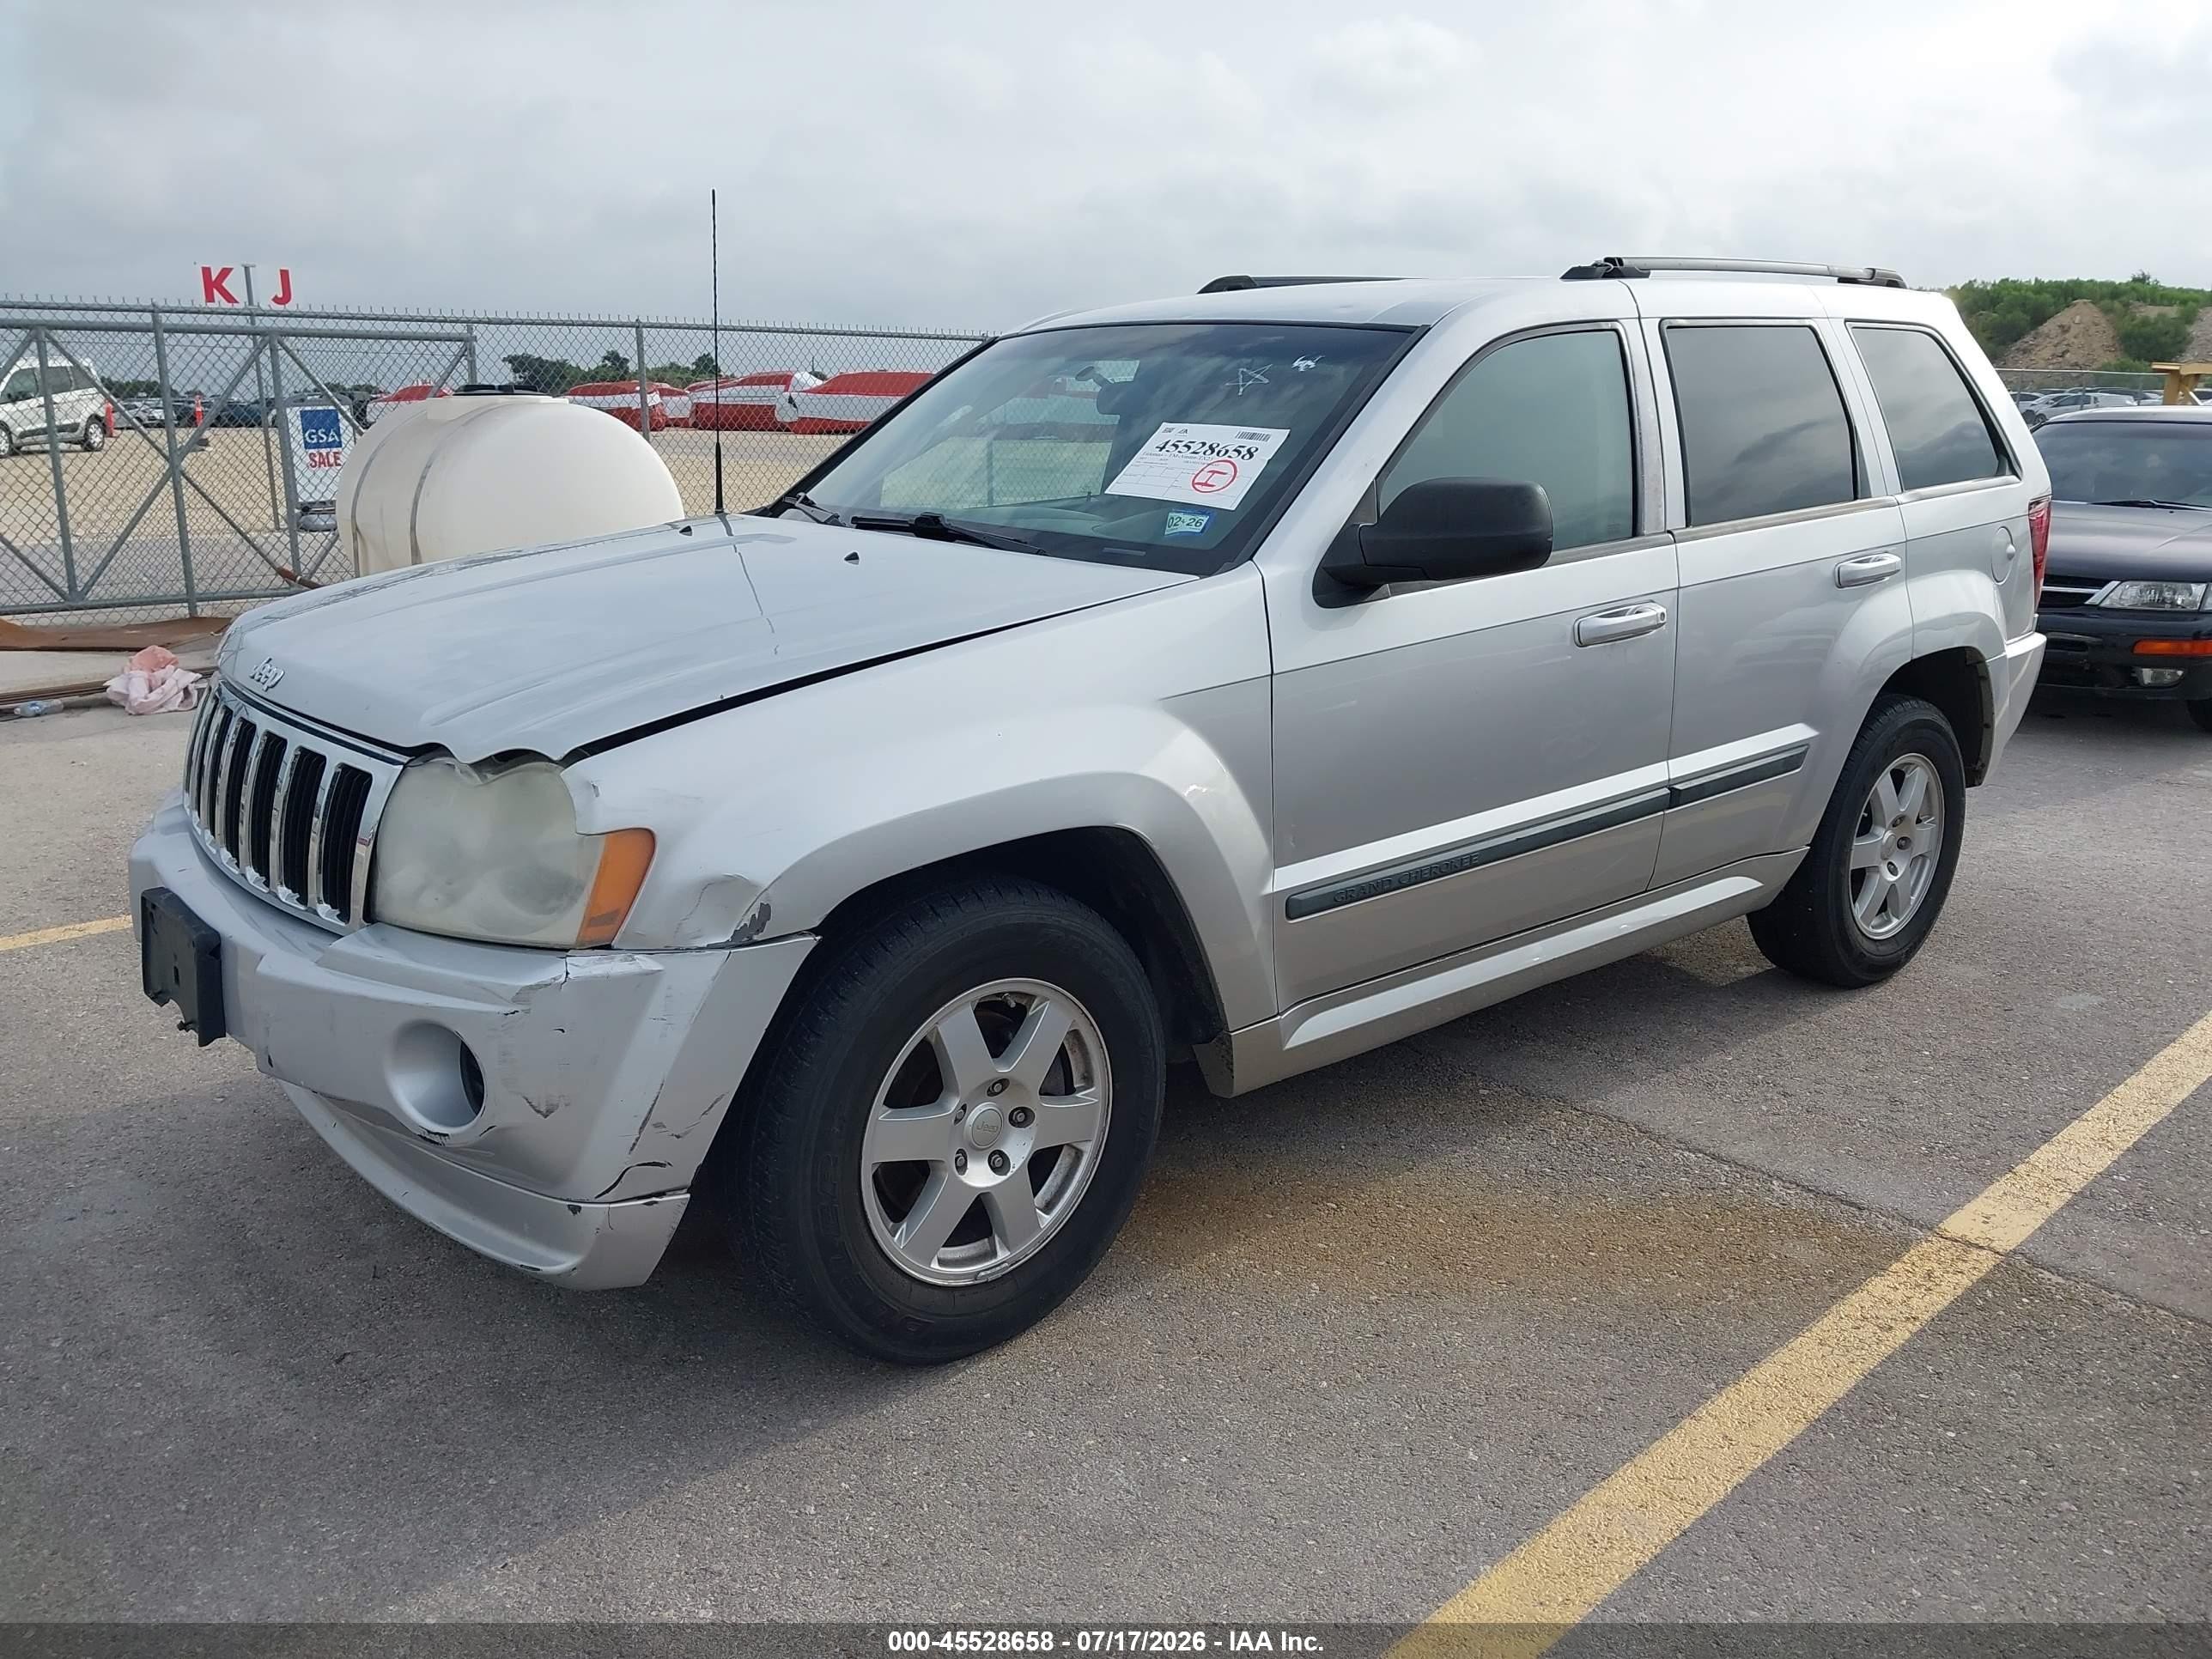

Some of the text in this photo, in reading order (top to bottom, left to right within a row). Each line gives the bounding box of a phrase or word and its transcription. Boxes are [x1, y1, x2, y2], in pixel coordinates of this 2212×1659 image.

[201, 266, 240, 304] K
[271, 269, 292, 306] J
[305, 428, 340, 443] GSA
[1155, 439, 1259, 461] 45528658
[308, 452, 342, 468] SALE
[1168, 516, 1205, 528] 02 26
[249, 656, 286, 692] Jeep
[1334, 853, 1480, 902] GRAND CHEROKEE
